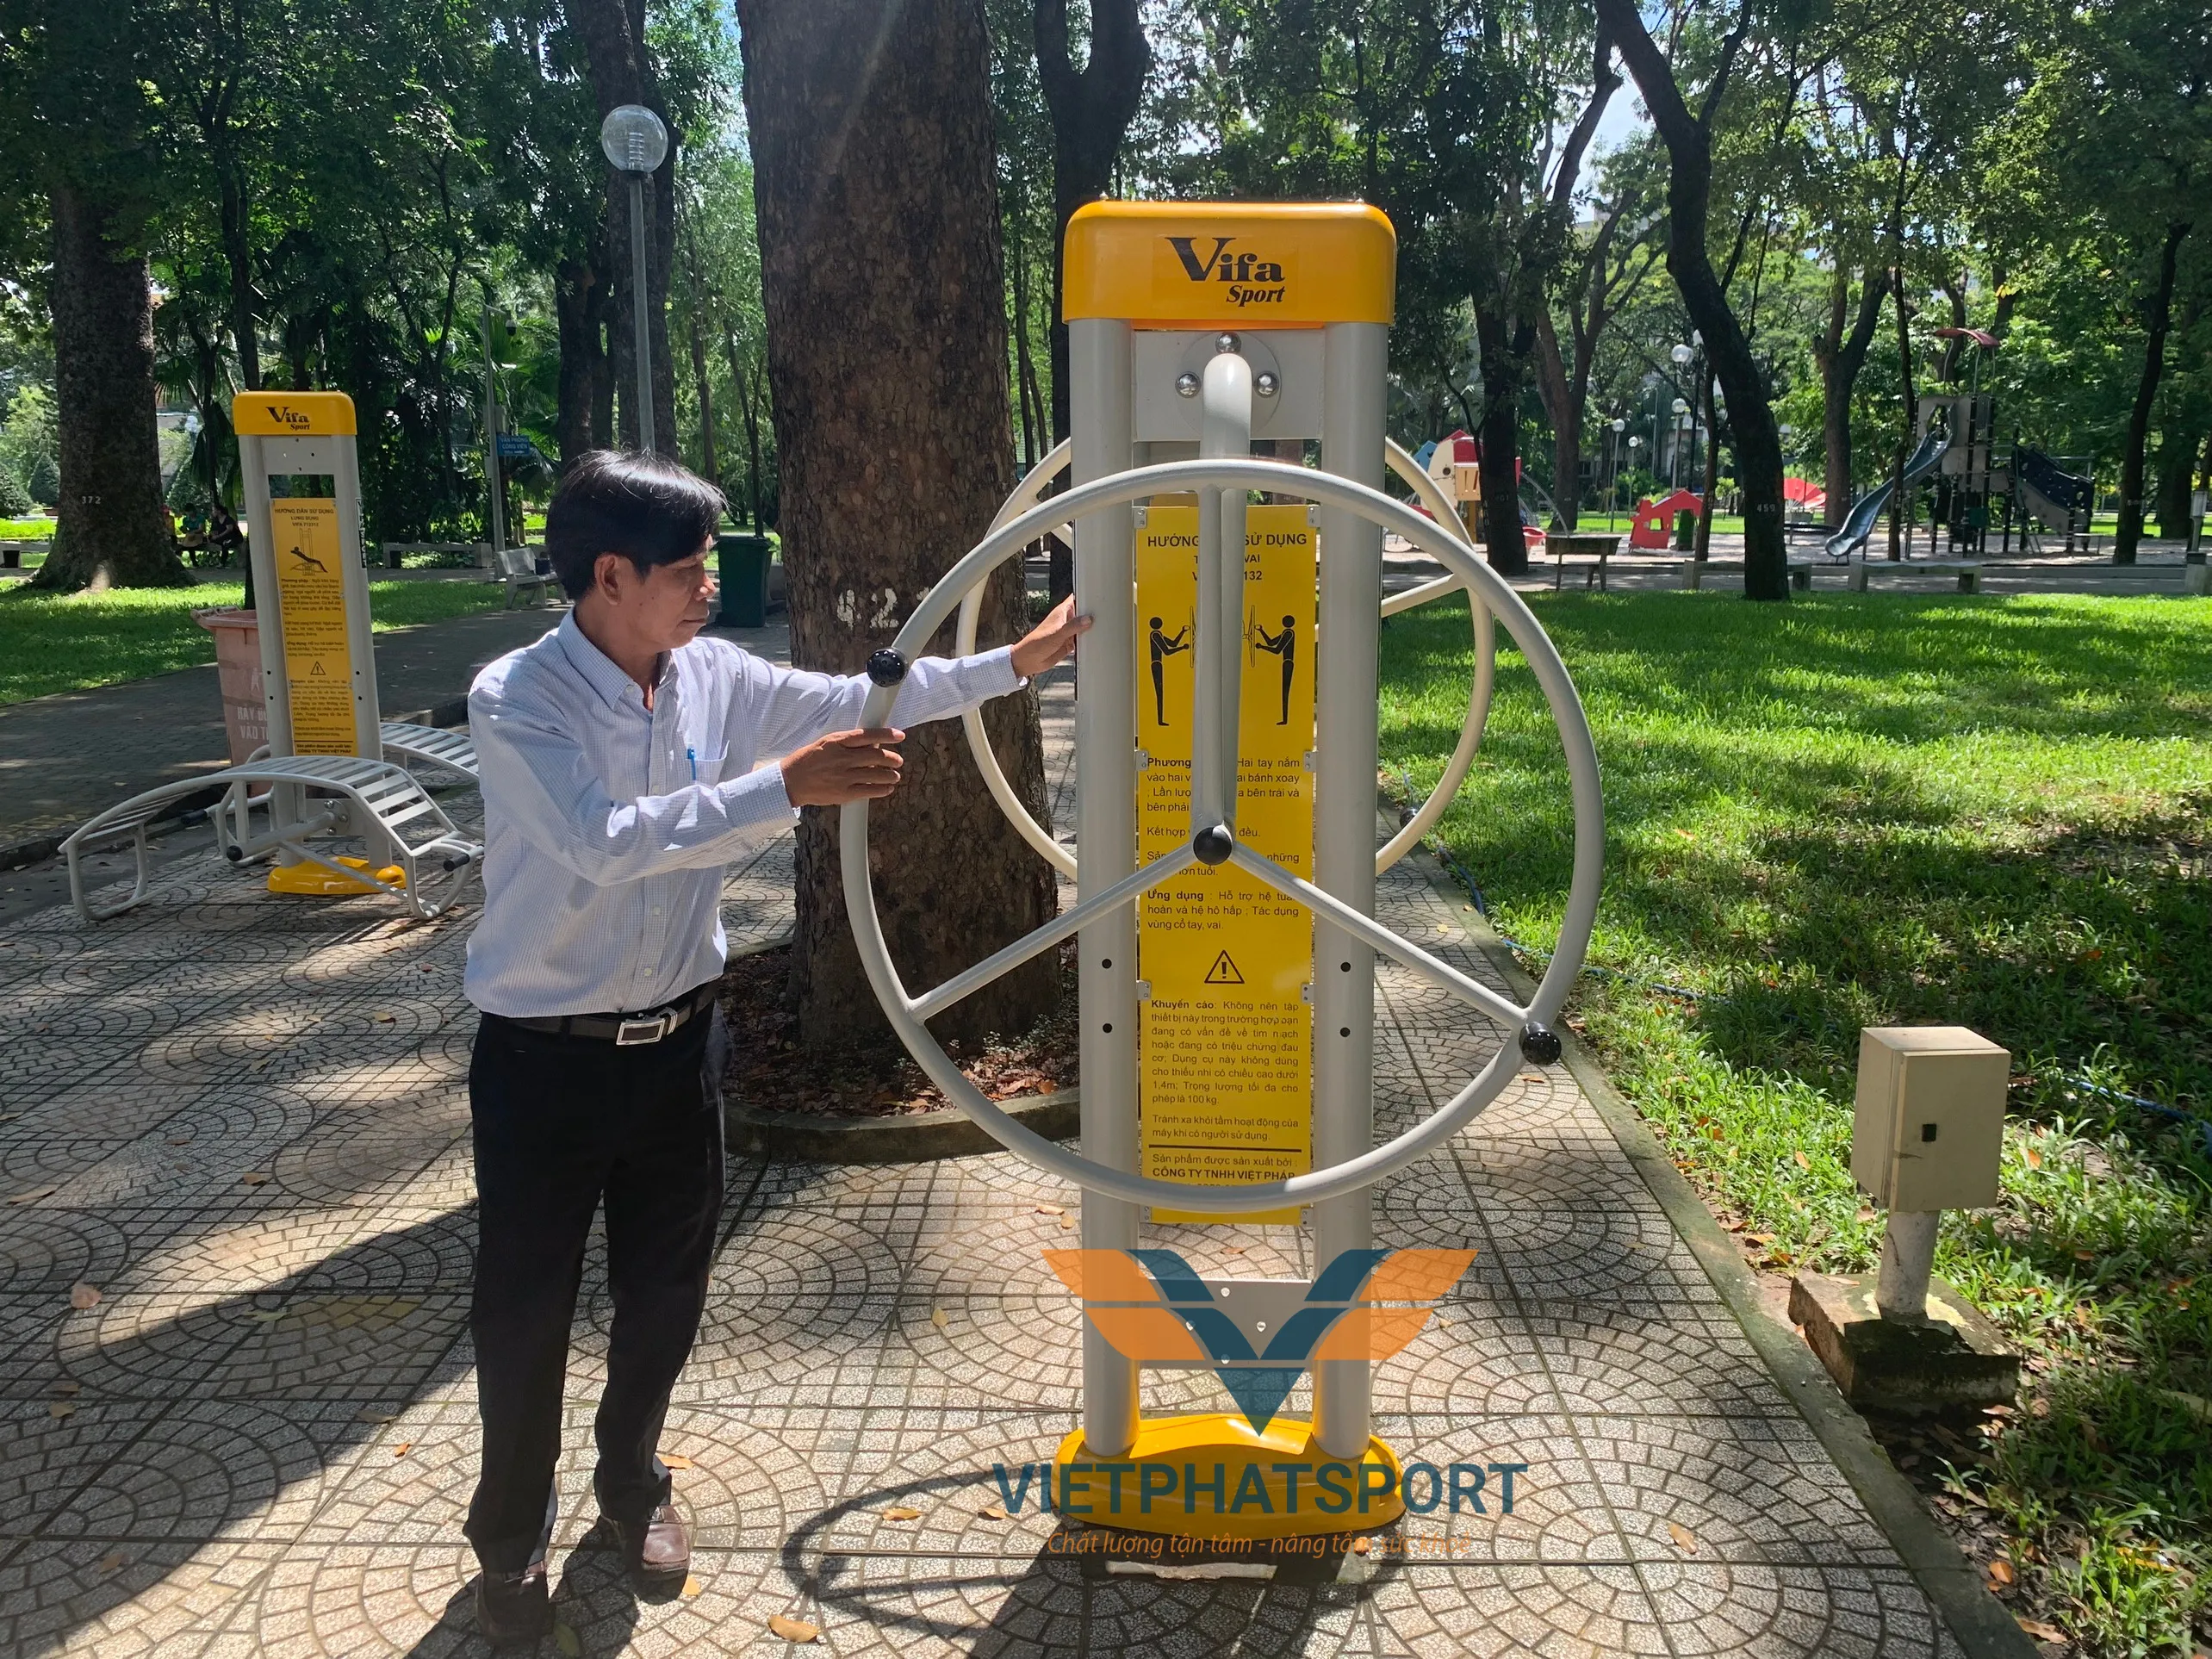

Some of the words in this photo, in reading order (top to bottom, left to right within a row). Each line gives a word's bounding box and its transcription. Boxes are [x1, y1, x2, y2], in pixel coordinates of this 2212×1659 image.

[1165, 237, 1285, 282] Vifa
[1226, 284, 1285, 307] Sport
[265, 407, 310, 423] Vifa
[82, 496, 101, 505] 372
[1757, 503, 1775, 513] 459
[1147, 532, 1198, 547] HƯỚNG
[1266, 533, 1307, 548] DỤNG
[1147, 758, 1191, 768] Phương
[1258, 759, 1273, 769] tay
[1277, 756, 1300, 767] nắm
[1146, 773, 1165, 782] vào
[1168, 773, 1183, 782] hai
[1248, 773, 1273, 783] bánh
[1276, 775, 1300, 785] xoay
[1153, 786, 1172, 797] Lần
[1247, 788, 1266, 798] bên
[1269, 788, 1285, 798] trái
[1288, 788, 1300, 798] và
[1147, 802, 1165, 811] bên
[1146, 825, 1164, 836] Kết
[1166, 827, 1186, 838] hợp
[1267, 853, 1300, 864] những
[1176, 891, 1204, 902] dụng
[1239, 892, 1253, 902] trợ
[1259, 892, 1271, 902] hệ
[1147, 904, 1172, 914] hoàn
[1191, 905, 1204, 916] hệ
[1207, 905, 1220, 915] hô
[1223, 904, 1242, 916] hấp
[1252, 906, 1271, 916] Tác
[1274, 907, 1299, 917] dụng
[1147, 920, 1171, 930] vùng
[1173, 918, 1186, 929] cổ
[1152, 999, 1190, 1010] Khuyến
[1223, 1001, 1253, 1012] Không
[1283, 1003, 1299, 1012] tập
[1152, 1012, 1171, 1022] thiết
[1172, 1014, 1181, 1023] bị
[1183, 1015, 1200, 1024] này
[1201, 1015, 1225, 1025] trong
[1227, 1015, 1258, 1025] trường
[1152, 1027, 1175, 1037] đang
[1197, 1026, 1214, 1036] vấn
[1219, 1027, 1231, 1037] đề
[1237, 1027, 1248, 1037] về
[1253, 1029, 1267, 1038] tim
[1152, 1041, 1175, 1050] hoặc
[1178, 1041, 1202, 1052] đang
[1246, 1042, 1277, 1053] chứng
[1281, 1043, 1299, 1052] đau
[1172, 1054, 1197, 1065] Dụng
[1202, 1056, 1214, 1065] cụ
[1219, 1055, 1236, 1066] này
[1241, 1056, 1270, 1066] không
[1275, 1057, 1299, 1067] dùng
[1152, 1067, 1169, 1076] cho
[1171, 1066, 1195, 1077] thiếu
[1215, 1069, 1226, 1078] có
[1184, 1081, 1210, 1092] Trọng
[1215, 1082, 1243, 1093] lượng
[1177, 1095, 1185, 1103] là
[1188, 1095, 1204, 1103] 100
[1153, 1115, 1179, 1123] Tránh
[1234, 1117, 1255, 1127] hoạt
[1256, 1118, 1280, 1128] động
[1282, 1119, 1299, 1128] của
[1153, 1128, 1172, 1139] máy
[1173, 1128, 1187, 1137] khi
[1189, 1129, 1200, 1138] có
[1202, 1130, 1229, 1140] người
[1204, 1155, 1230, 1165] được
[1233, 1156, 1250, 1165] sản
[1253, 1156, 1274, 1166] xuất
[1153, 1165, 1186, 1177] CÔNG
[1188, 1169, 1202, 1177] TY
[1204, 1169, 1235, 1178] TNHH
[1237, 1169, 1262, 1181] VIỆT
